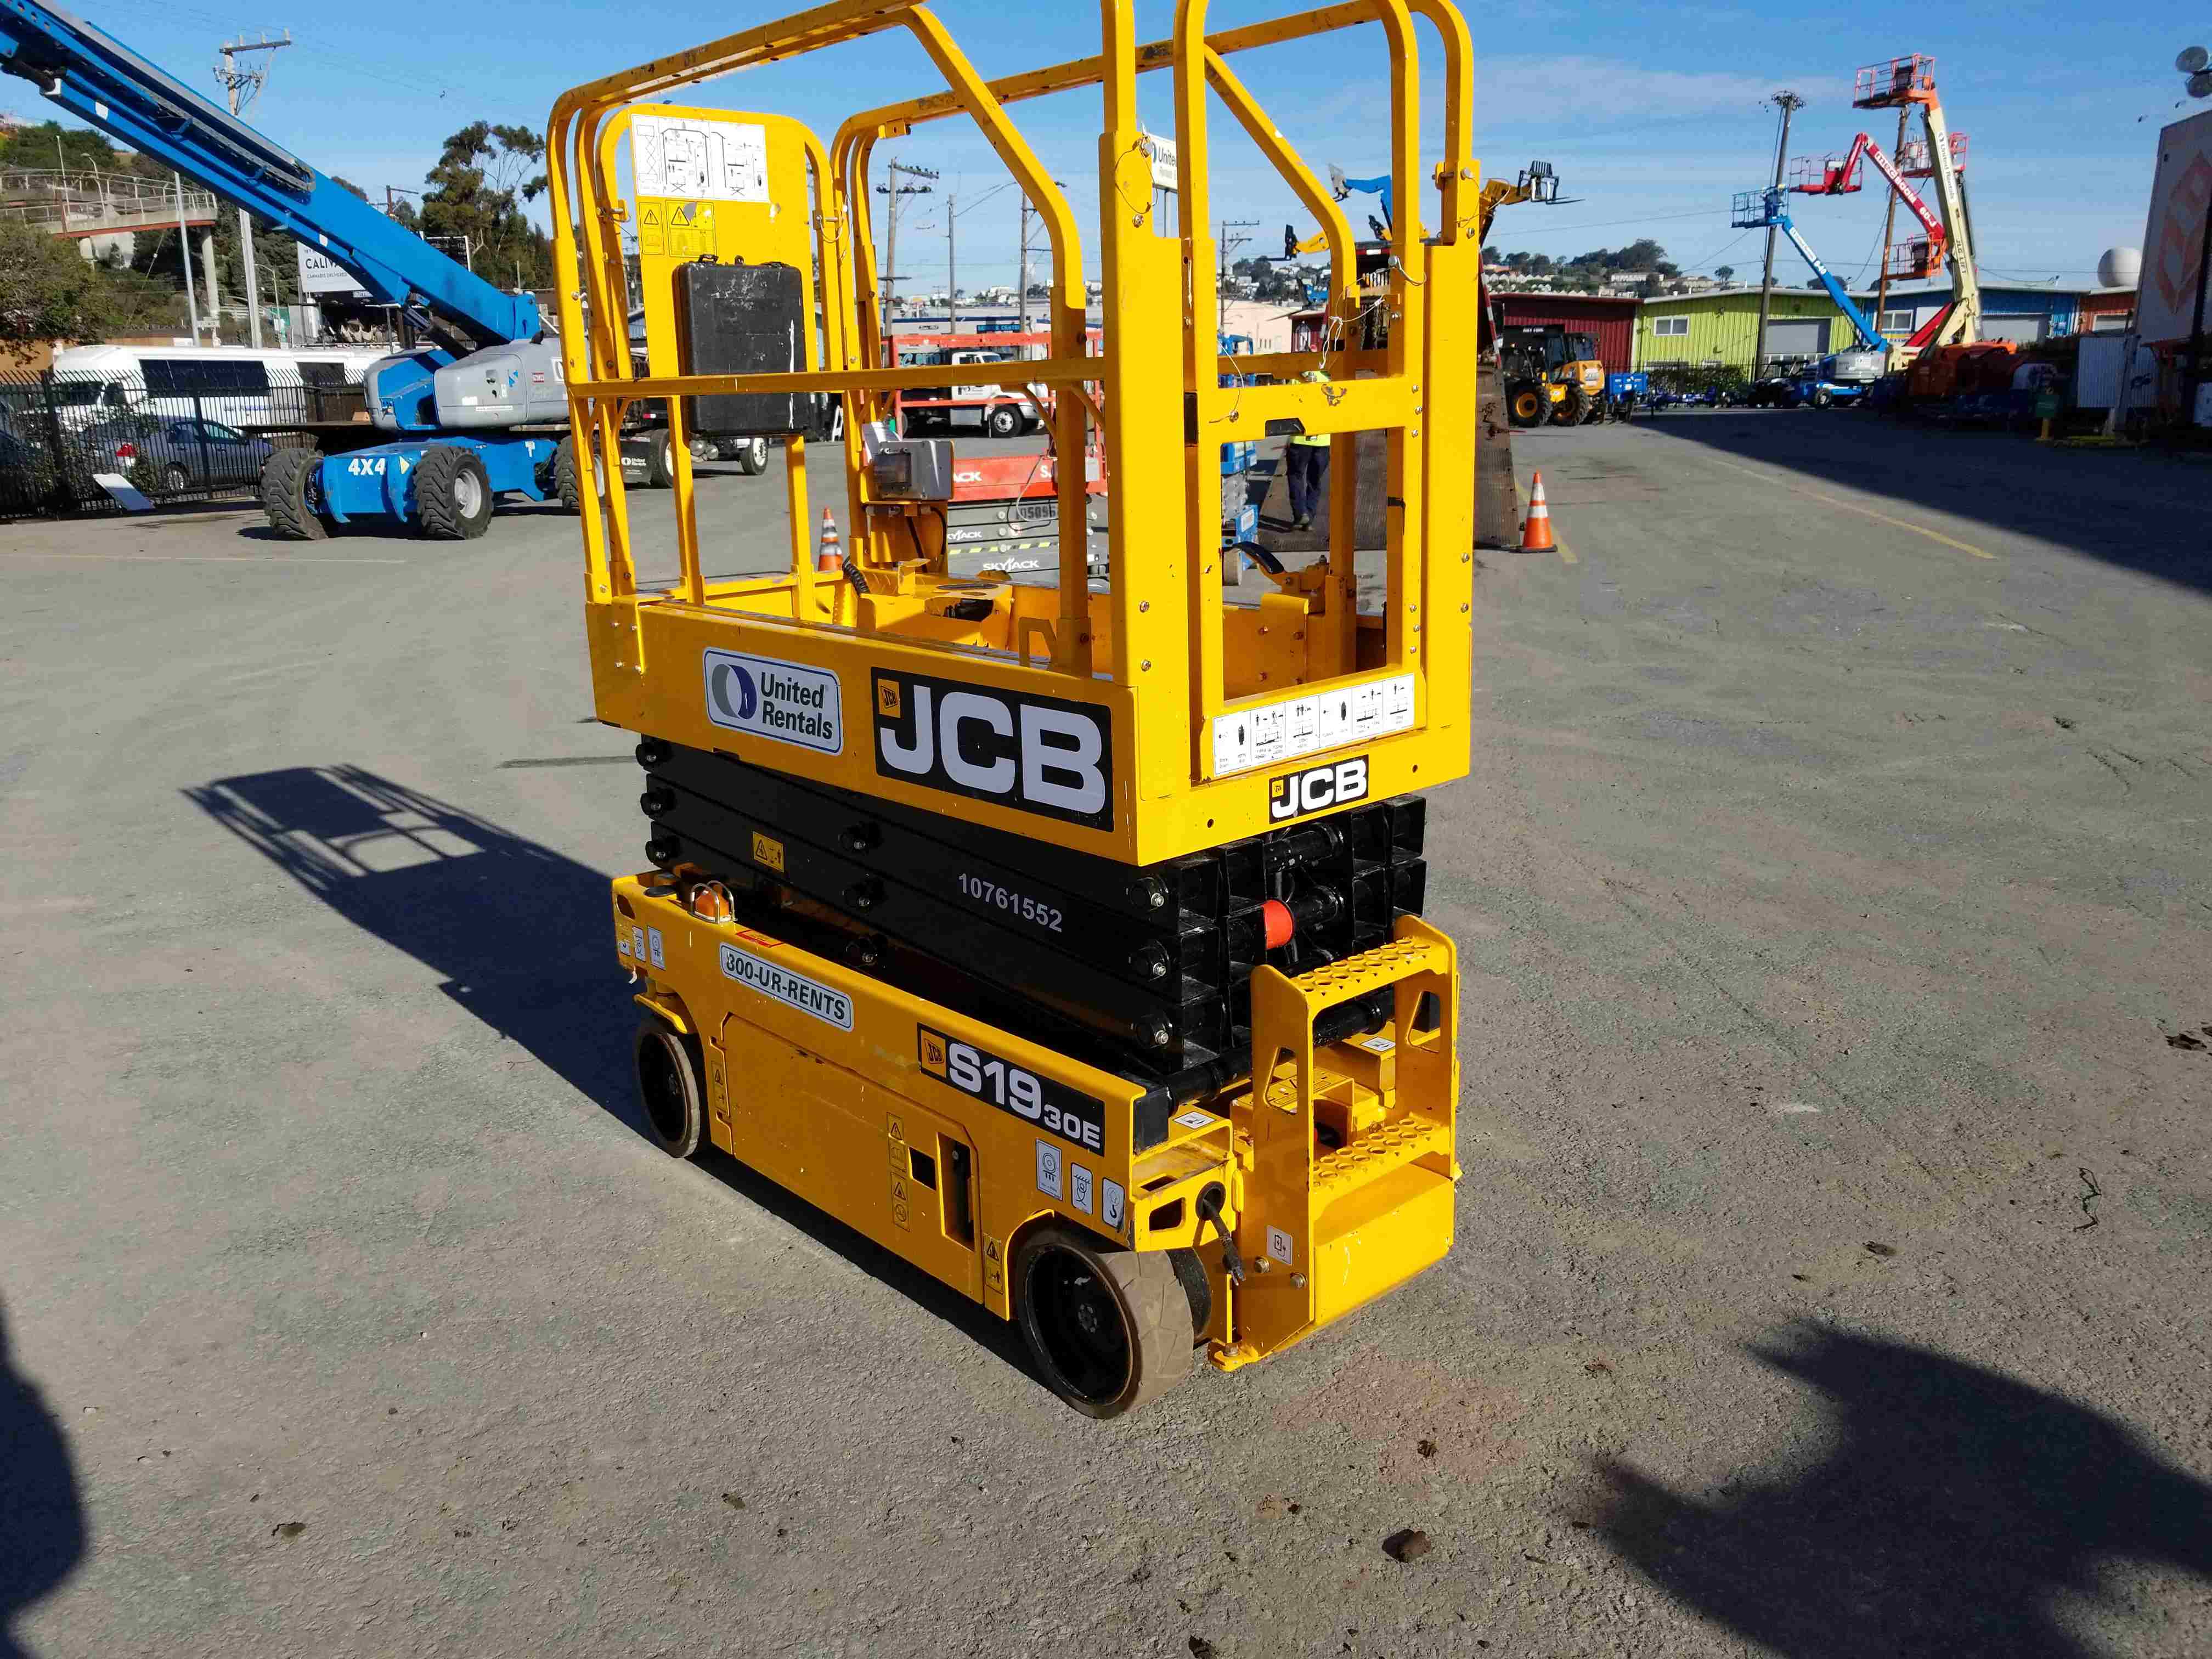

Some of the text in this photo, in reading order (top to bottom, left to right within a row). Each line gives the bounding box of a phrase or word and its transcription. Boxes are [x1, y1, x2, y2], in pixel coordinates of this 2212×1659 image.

[1158, 146, 1177, 167] Unite
[348, 458, 386, 476] 4X4
[947, 529, 983, 541] KYJACK
[983, 557, 1040, 571] SKYJACK
[761, 672, 825, 709] United
[884, 689, 898, 707] JCB
[762, 700, 833, 740] Rentals
[880, 684, 1106, 814] JCB
[1272, 759, 1367, 819] JCB
[958, 873, 1062, 933] 10761552
[949, 1042, 1101, 1149] S19 30E
